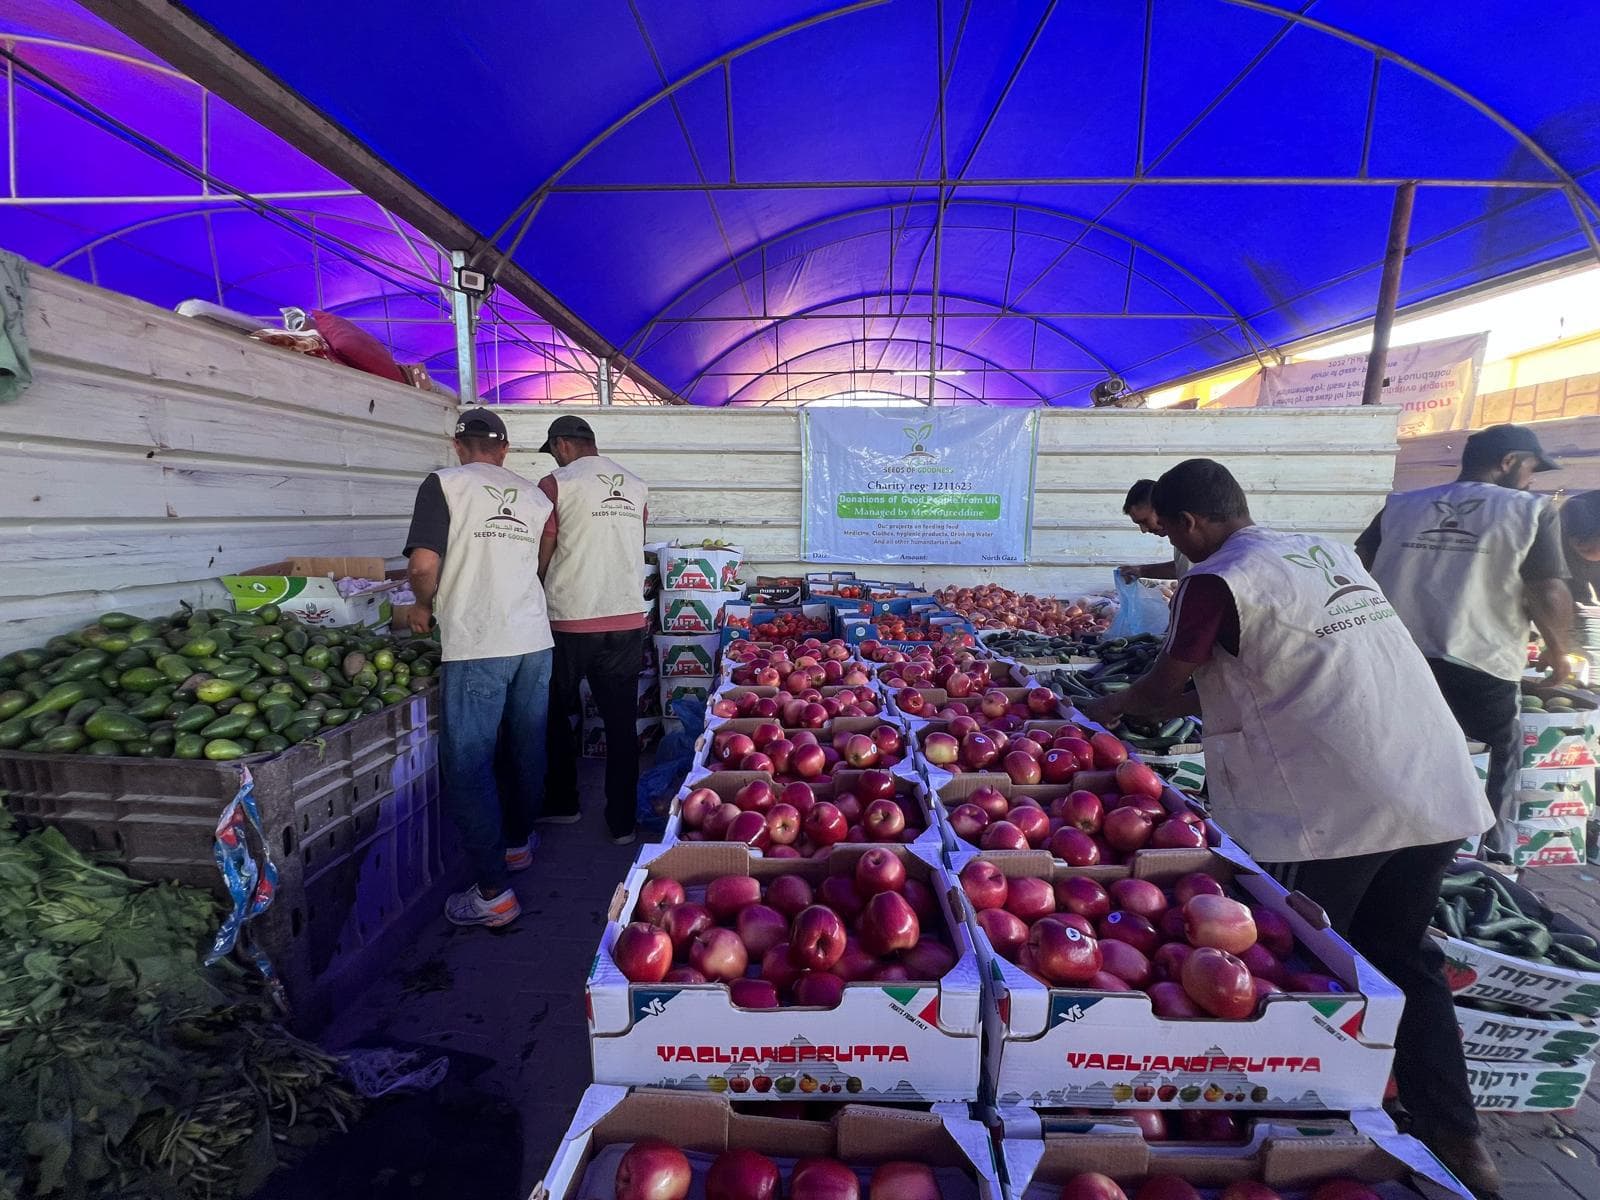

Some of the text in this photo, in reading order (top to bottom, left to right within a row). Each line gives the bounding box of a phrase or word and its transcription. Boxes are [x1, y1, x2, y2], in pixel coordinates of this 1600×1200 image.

[867, 481, 906, 492] Charity
[909, 482, 929, 492] reg:
[839, 495, 885, 504] Donations
[888, 495, 898, 504] of
[901, 495, 924, 504] Good
[960, 496, 983, 504] from
[984, 495, 998, 504] UK
[854, 507, 895, 518] Managed
[897, 507, 909, 518] by
[981, 554, 1017, 562] North Gaza
[1314, 619, 1353, 638] SEEDS
[1353, 614, 1367, 626] OF
[1488, 965, 1572, 991] ירקות
[641, 997, 667, 1017] VF
[1059, 1004, 1085, 1023] VF
[1474, 1020, 1550, 1042] ירקות
